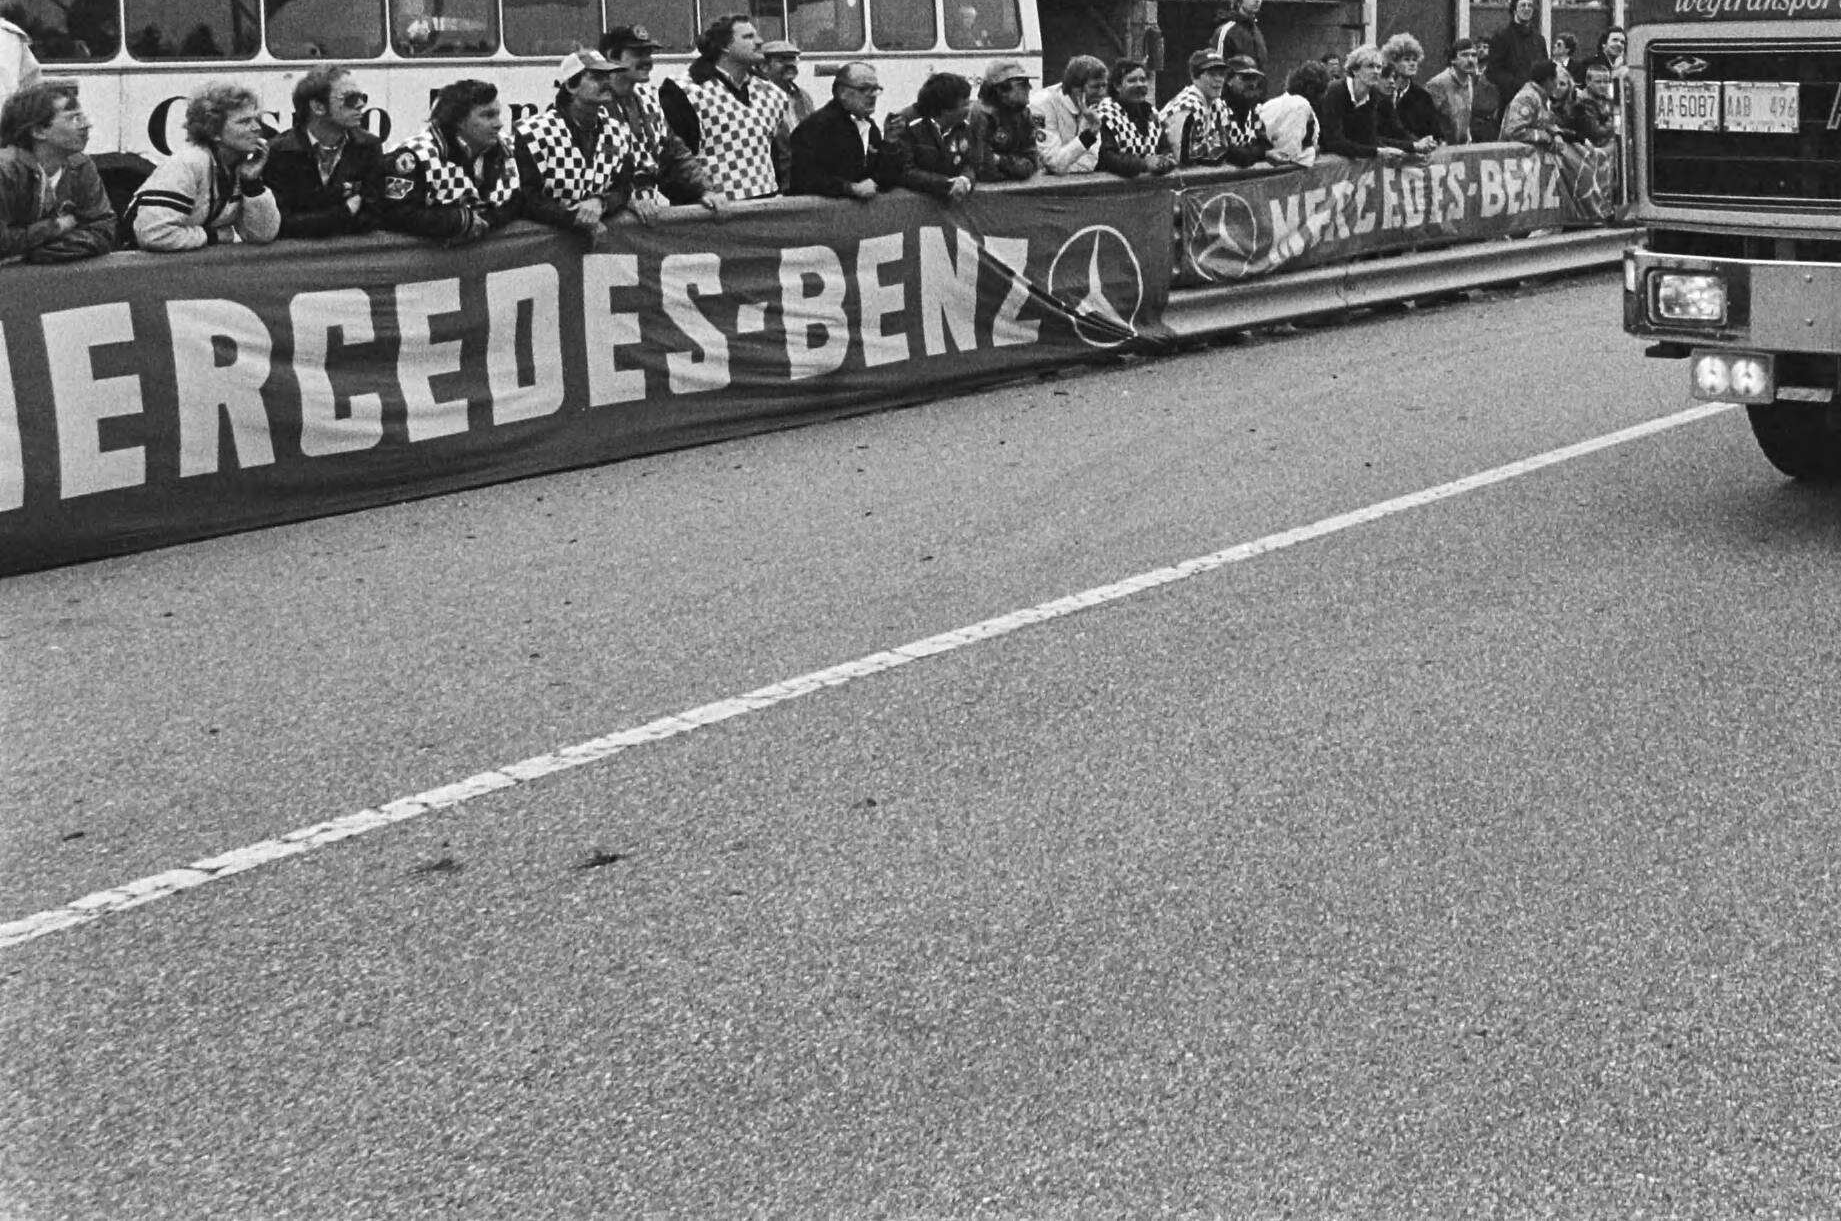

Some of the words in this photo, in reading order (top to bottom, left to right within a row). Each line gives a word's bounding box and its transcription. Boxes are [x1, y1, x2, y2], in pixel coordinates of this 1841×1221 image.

[1726, 95, 1752, 117] AAB
[1268, 154, 1561, 261] MERCEDES-BENZ
[0, 225, 1041, 513] ERCEDES-BENZ
